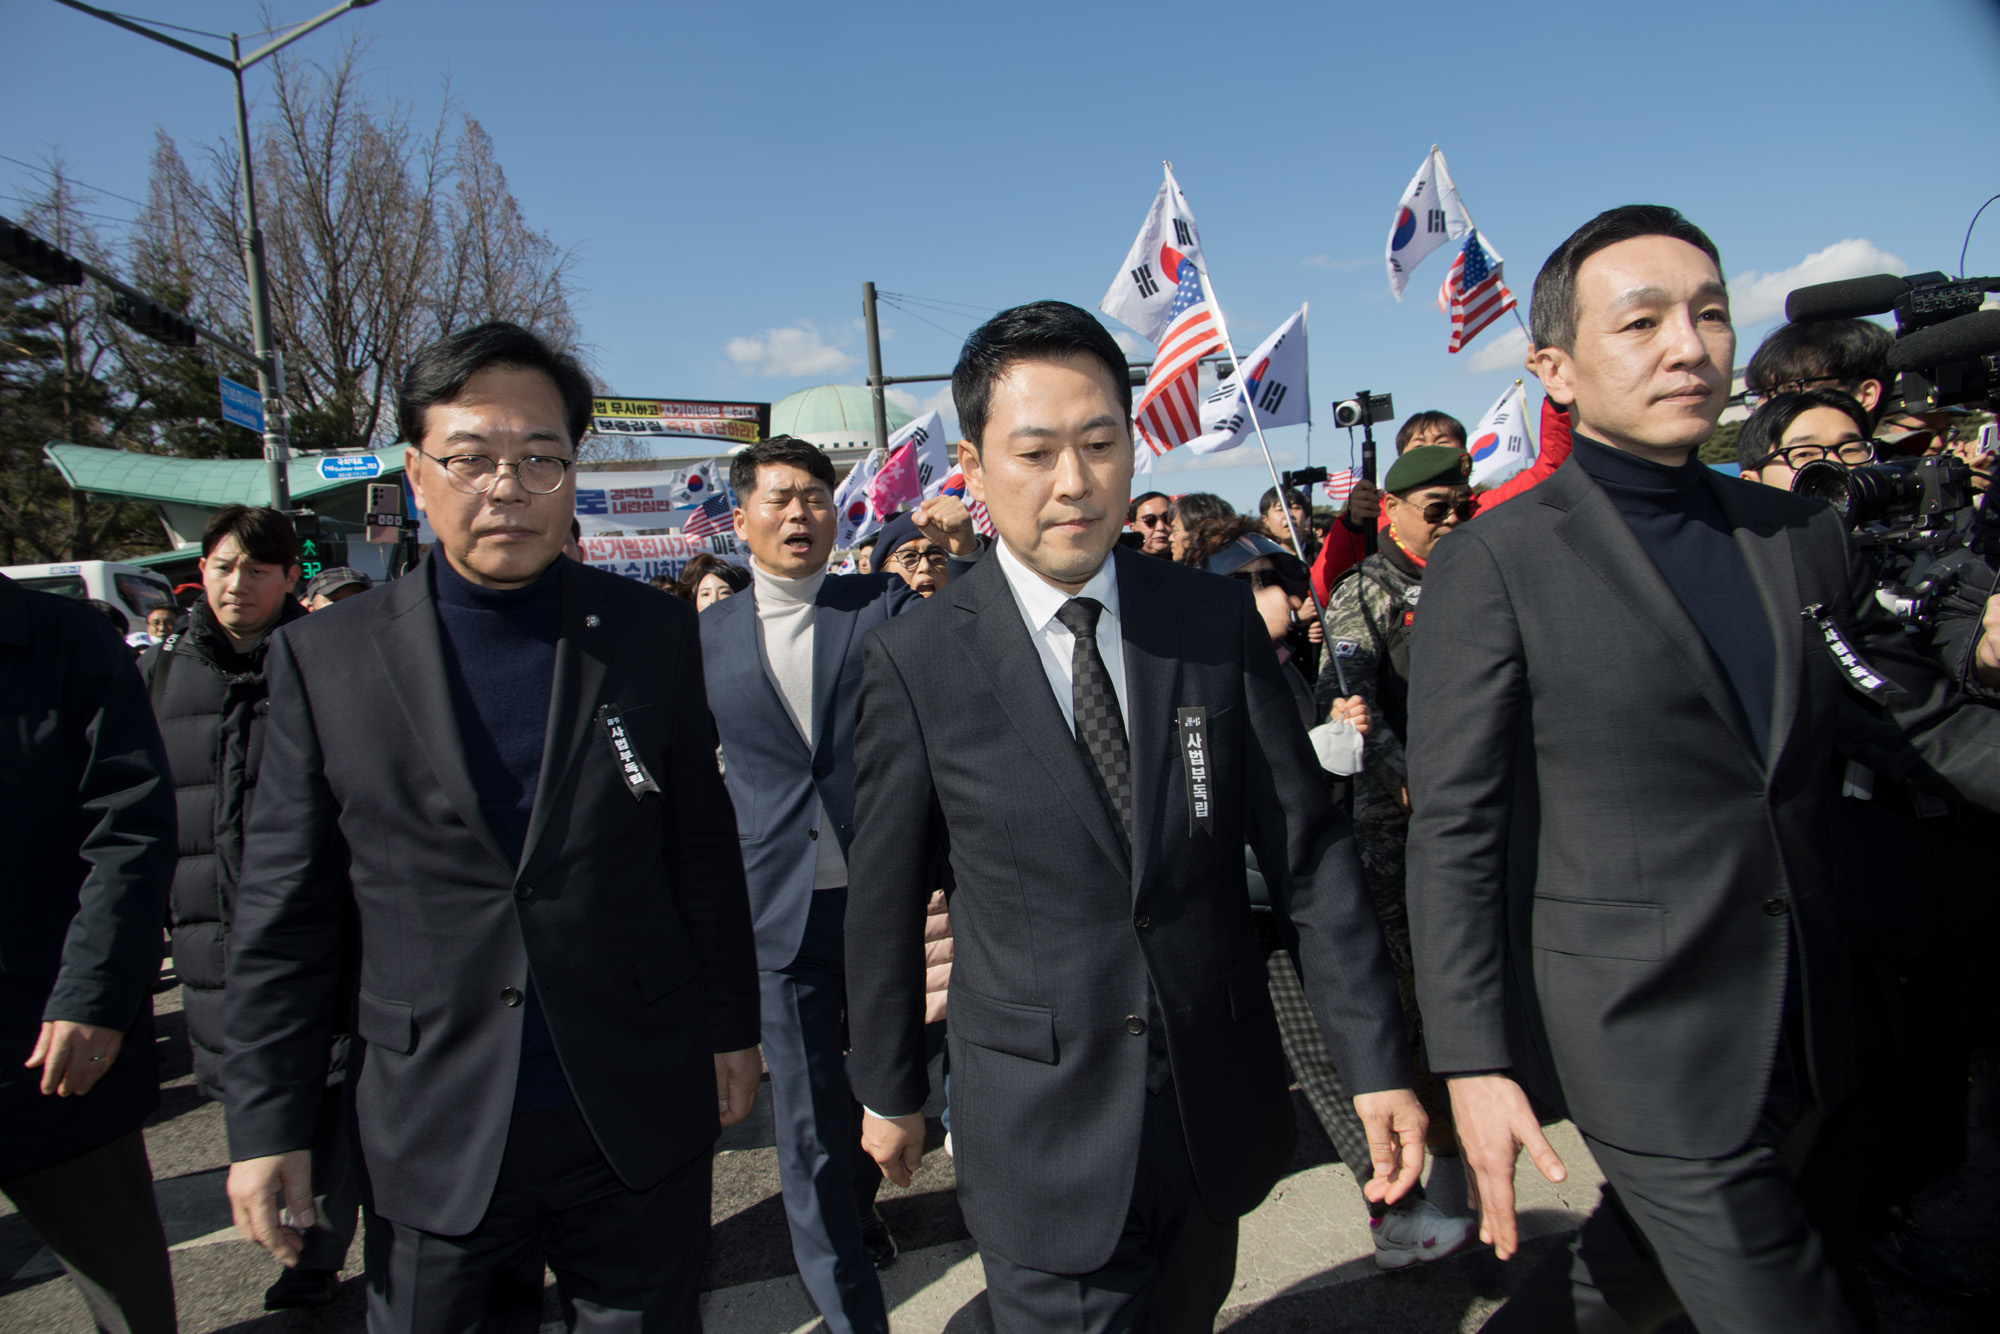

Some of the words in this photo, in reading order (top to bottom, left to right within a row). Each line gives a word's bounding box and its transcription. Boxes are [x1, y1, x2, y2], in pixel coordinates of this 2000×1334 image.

[610, 402, 658, 416] 무시하고
[598, 419, 664, 432] 보증갑질
[665, 420, 696, 433] 즉각
[698, 421, 756, 438] 중단하라!
[610, 487, 654, 500] 강력한
[612, 499, 670, 514] 내란심판
[580, 536, 707, 561] 선거범죄사기단
[302, 562, 322, 579] 32
[611, 725, 645, 786] 사법부독립
[1187, 732, 1209, 818] 사법부독립
